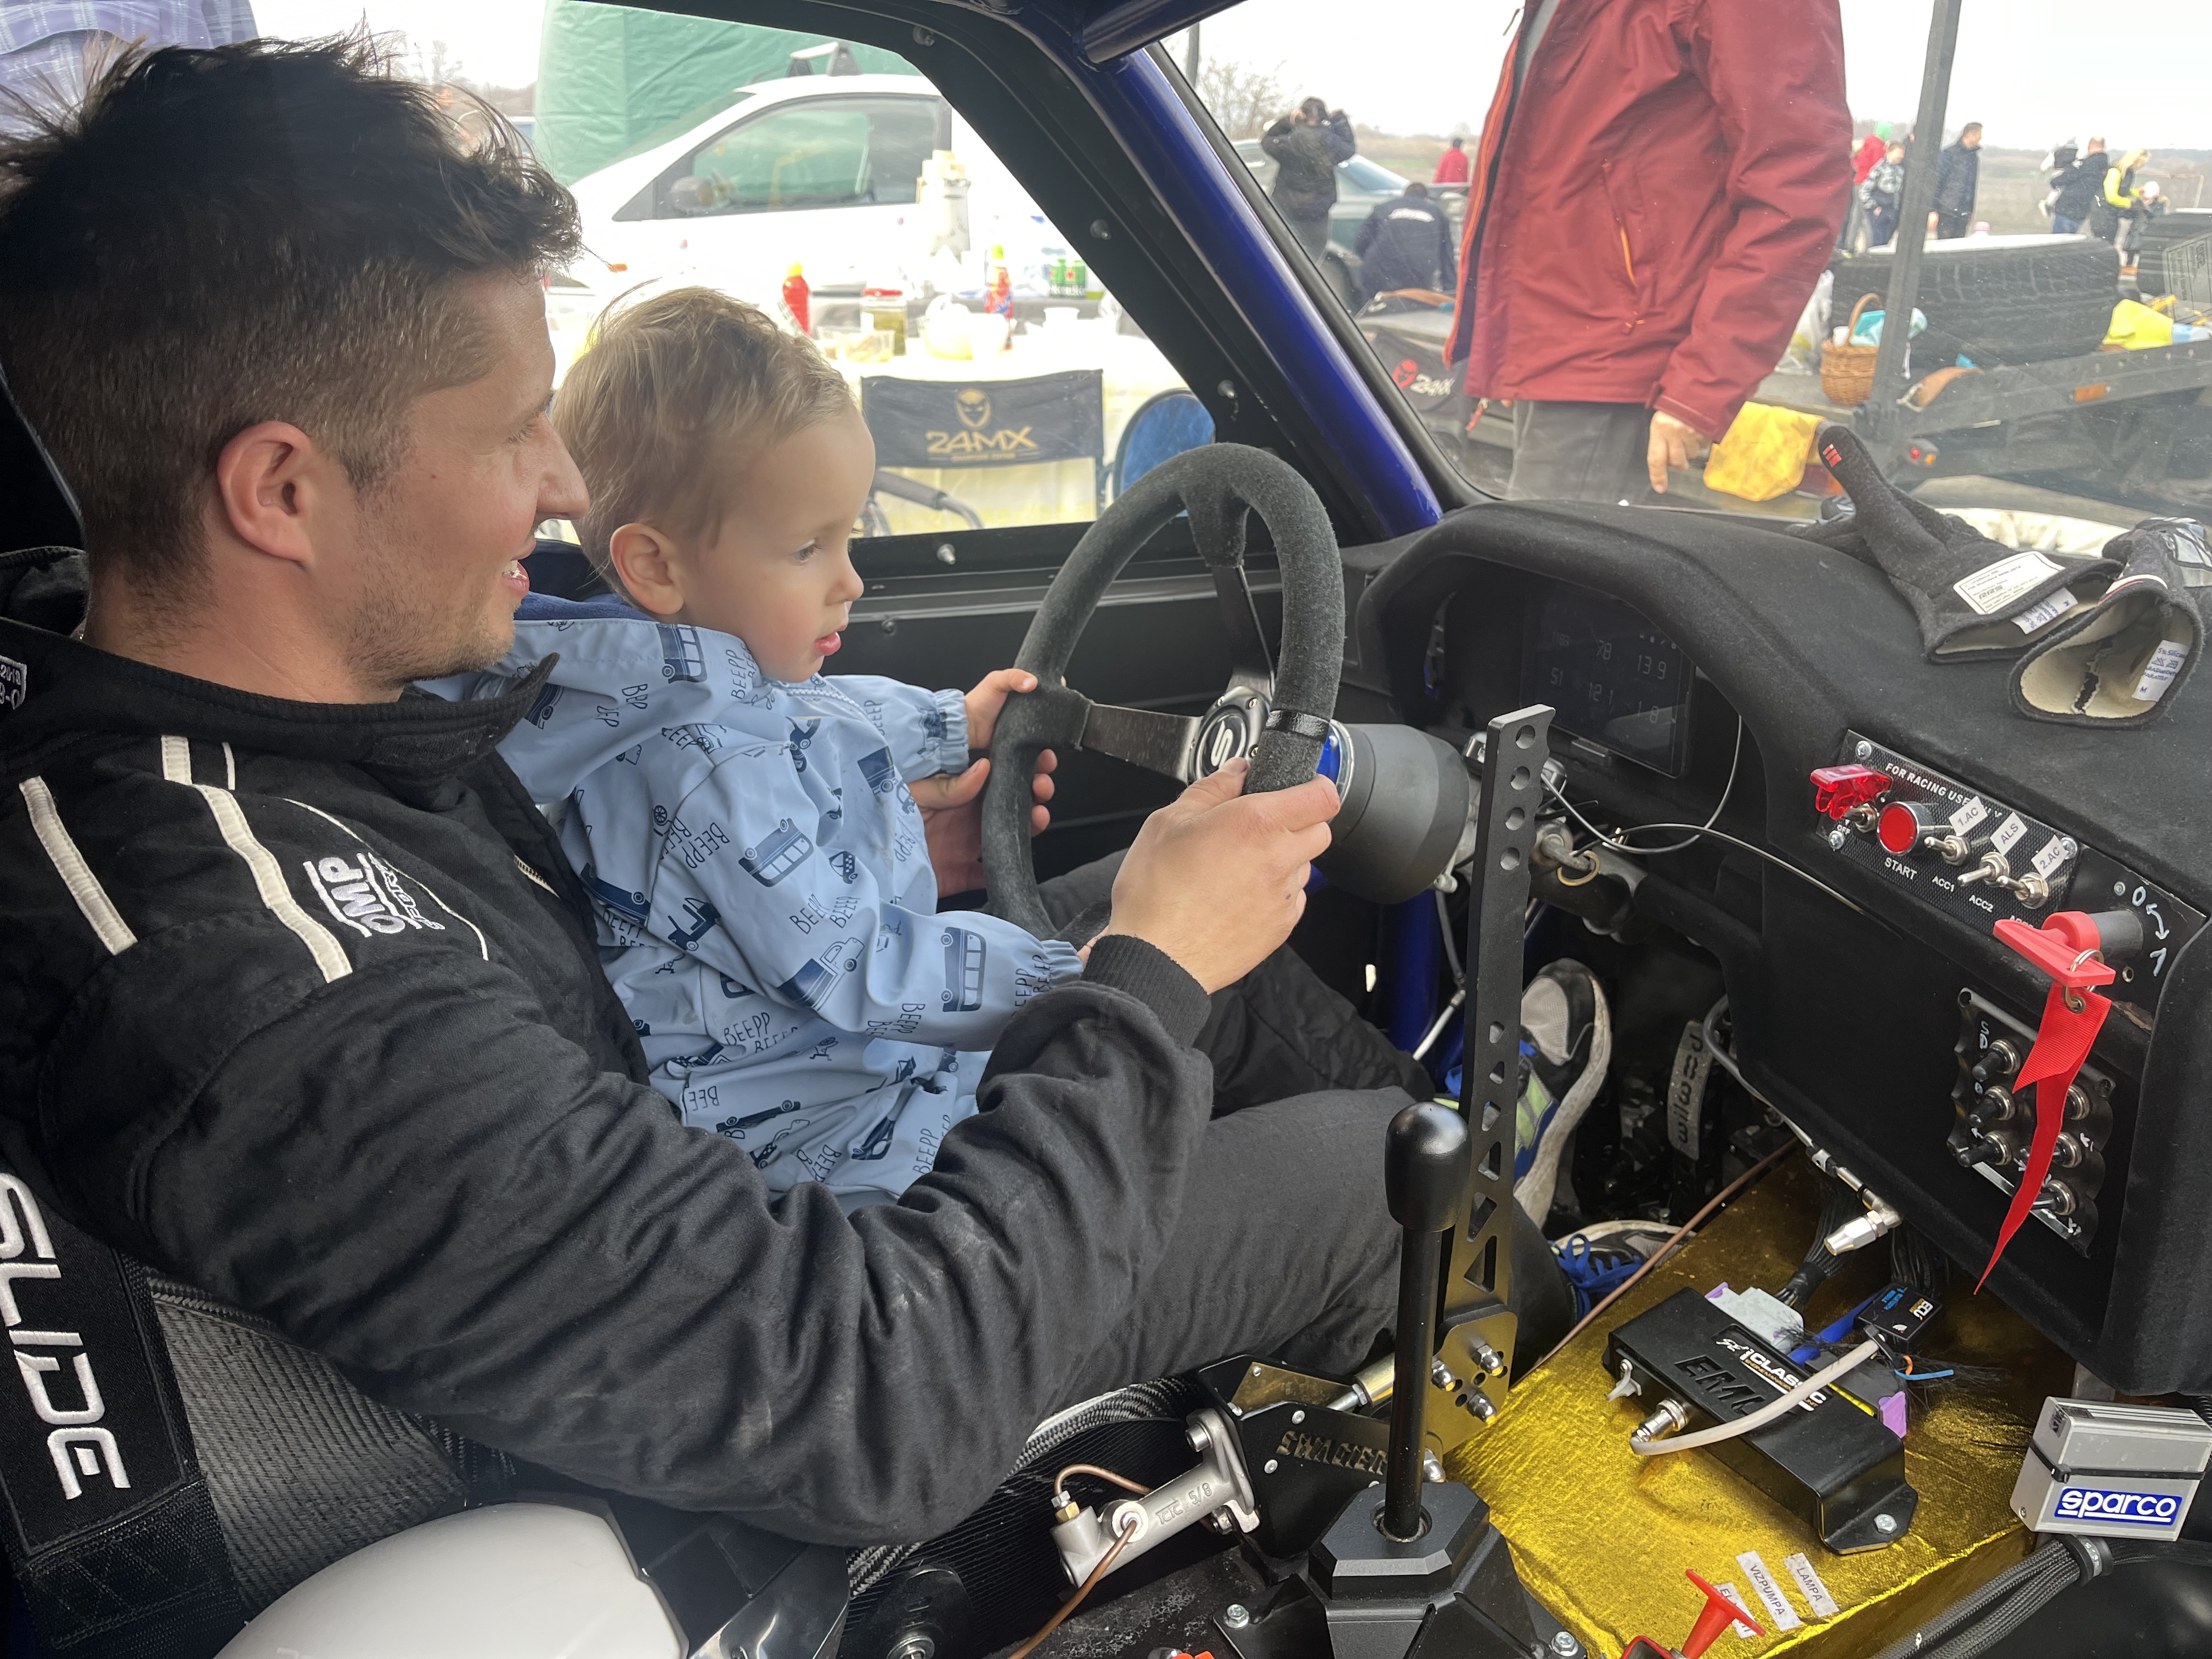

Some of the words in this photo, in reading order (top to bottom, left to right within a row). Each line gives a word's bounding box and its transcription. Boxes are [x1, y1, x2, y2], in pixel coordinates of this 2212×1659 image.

[925, 426, 1039, 454] 24MX
[725, 649, 747, 699] BEEPP
[1637, 654, 1667, 680] 13.9
[1886, 763, 1906, 778] FOR
[1906, 771, 1947, 796] RACING
[1836, 824, 1851, 834] OFF
[1957, 807, 1979, 826] 1.AC
[681, 822, 730, 869] BEEPP
[2001, 823, 2019, 844] ALS
[1885, 857, 1917, 879] START
[2040, 847, 2060, 870] 2.AC
[318, 856, 405, 934] OMP
[1932, 876, 1955, 892] ACC1
[1969, 894, 1993, 912] ACC2
[724, 1012, 770, 1046] BEEPP
[890, 1003, 926, 1034] BEEPP
[912, 1128, 939, 1175] BEEPP
[1913, 1300, 1934, 1318] ECU
[1750, 1352, 1826, 1404] CLASC
[1189, 1483, 1212, 1506] 5/8
[2062, 1487, 2177, 1519] sparco
[1750, 1564, 1786, 1617] VIZPUMPA
[1797, 1566, 1824, 1603] LAMPA
